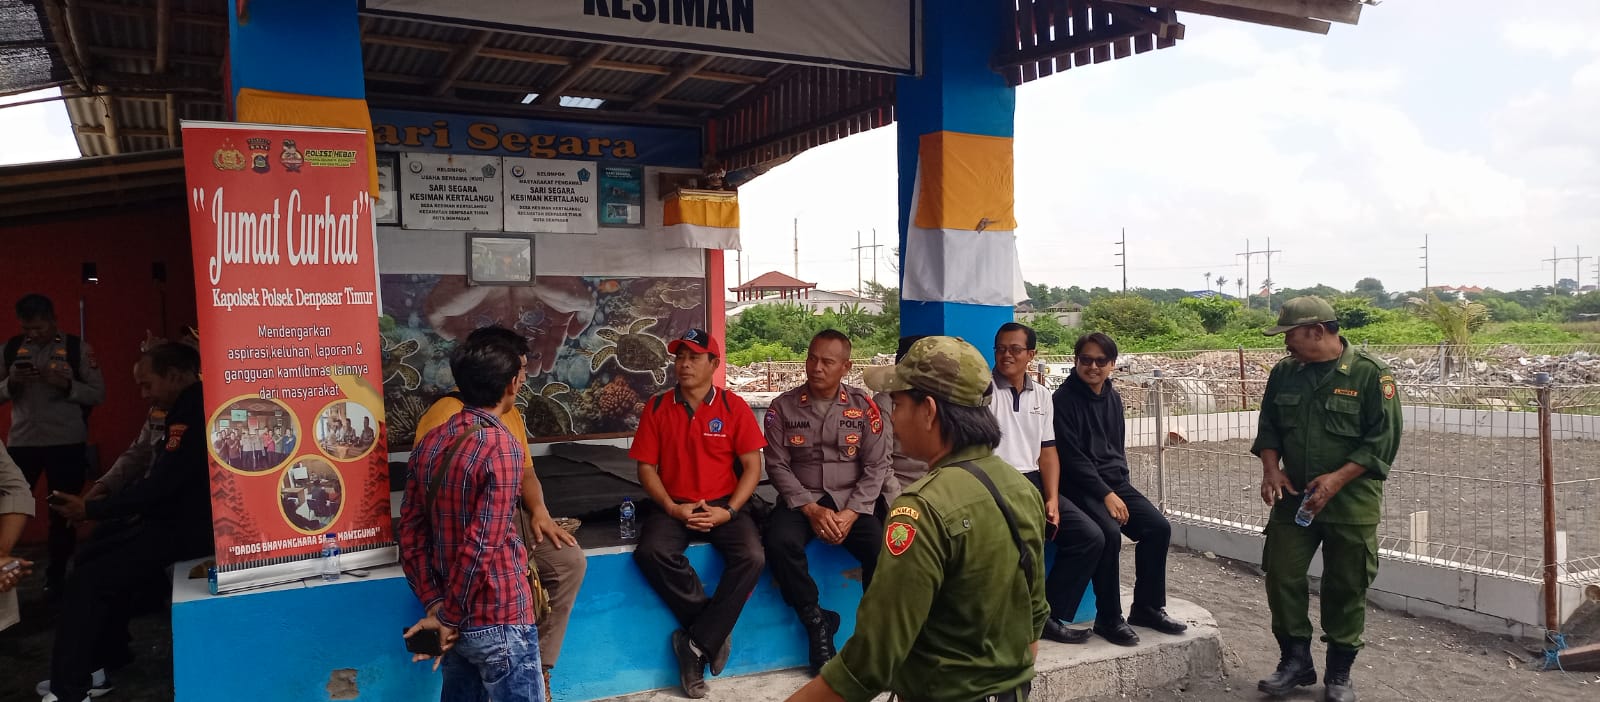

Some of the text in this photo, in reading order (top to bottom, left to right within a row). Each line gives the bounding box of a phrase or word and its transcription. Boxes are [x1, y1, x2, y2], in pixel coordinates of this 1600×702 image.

[374, 120, 638, 158] ari Segara
[334, 150, 356, 158] HEBAT
[429, 184, 477, 193] SARI SEGARA
[530, 186, 546, 194] SARI
[410, 193, 494, 203] KESIMAN KERTALANGU
[510, 194, 589, 204] KESIMAN KERTALANGU
[212, 287, 374, 311] Kapolsek Polsek Denpasar Timur
[258, 325, 331, 341] Mendengarkan
[315, 344, 353, 360] laporan
[356, 342, 363, 355] &
[224, 364, 369, 383] gangguan kamtibmas lainnya
[259, 384, 339, 400] dari masyarakat
[262, 537, 317, 552] BHAYANGKARA
